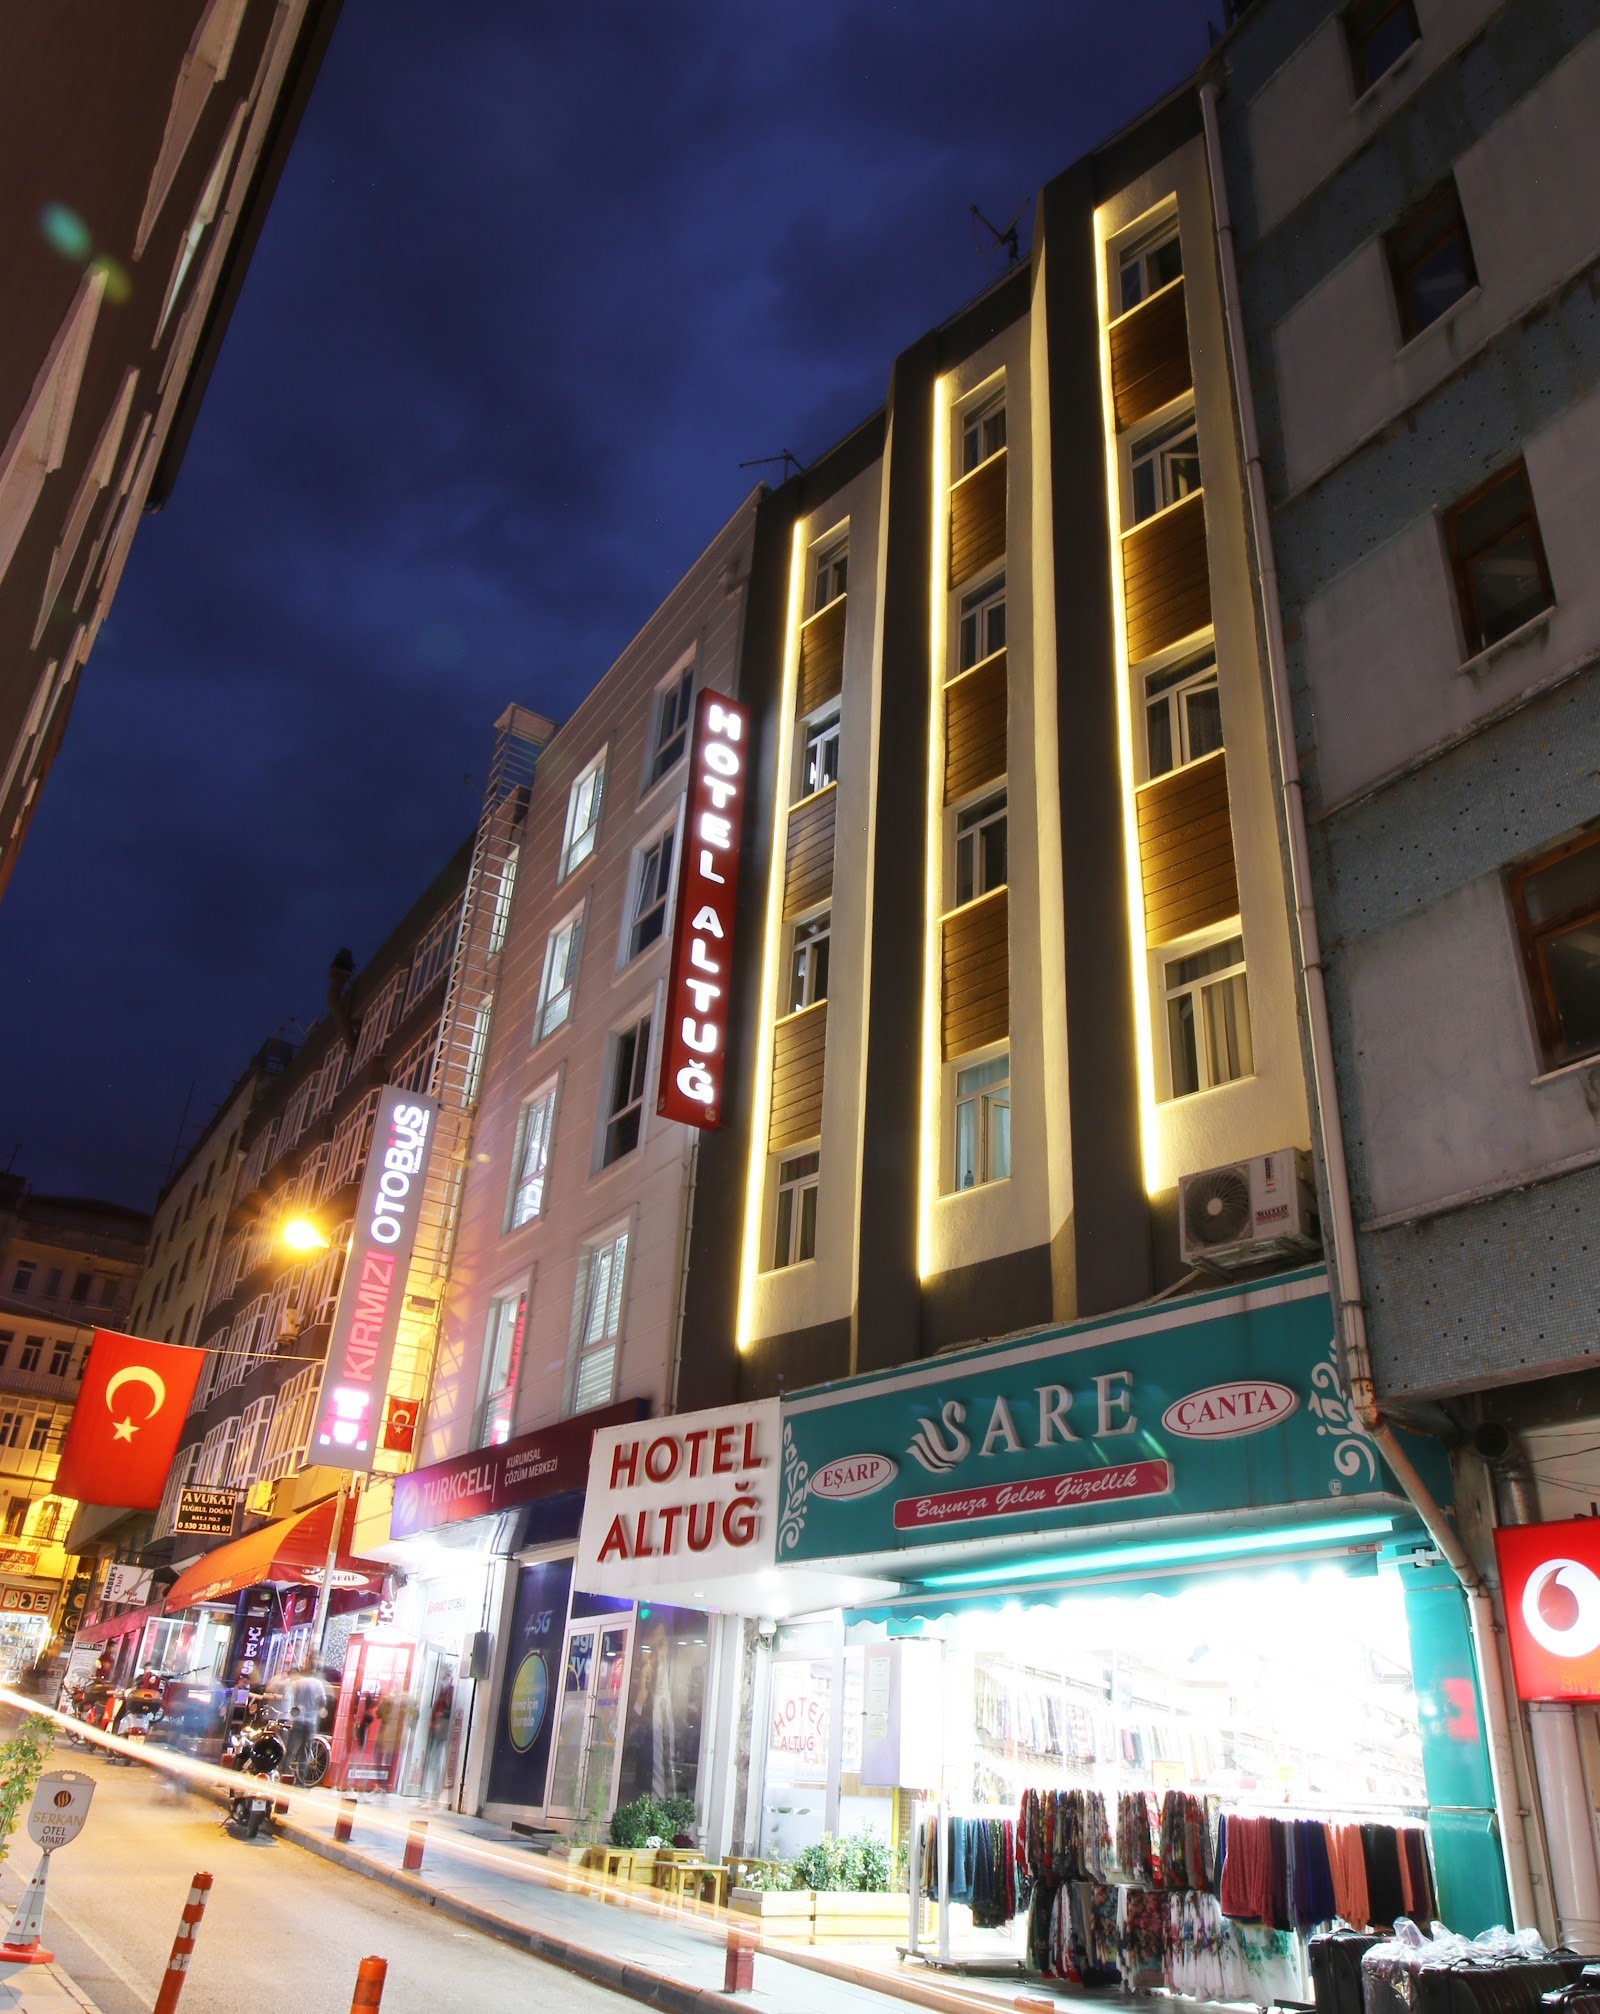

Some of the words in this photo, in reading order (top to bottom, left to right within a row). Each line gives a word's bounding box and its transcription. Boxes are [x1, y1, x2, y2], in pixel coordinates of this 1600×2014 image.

[699, 704, 743, 884] HOTEL
[676, 905, 724, 1105] ALTUĞ
[343, 1250, 396, 1383] KIRMIZI
[906, 1370, 1138, 1474] SARE
[1176, 1388, 1278, 1431] ÇANTA
[504, 1466, 529, 1487] ÇÖZÜM
[528, 1455, 558, 1479] MERKEZİ
[506, 1447, 542, 1468] KURUMSAL
[609, 1422, 764, 1490] HOTEL
[822, 1461, 881, 1489] EŞARP
[183, 1492, 235, 1505] AVUKAT
[423, 1463, 492, 1507] TURKCELL
[996, 1478, 1046, 1510] Gelen
[1054, 1467, 1139, 1504] Güzellik
[597, 1481, 760, 1562] ALTUĞ
[773, 1697, 824, 1736] HOTEL
[780, 1733, 815, 1751] ALTUĞ
[32, 1811, 84, 1826] SERKAN
[42, 1825, 67, 1836] OTEL
[39, 1835, 66, 1845] APART
